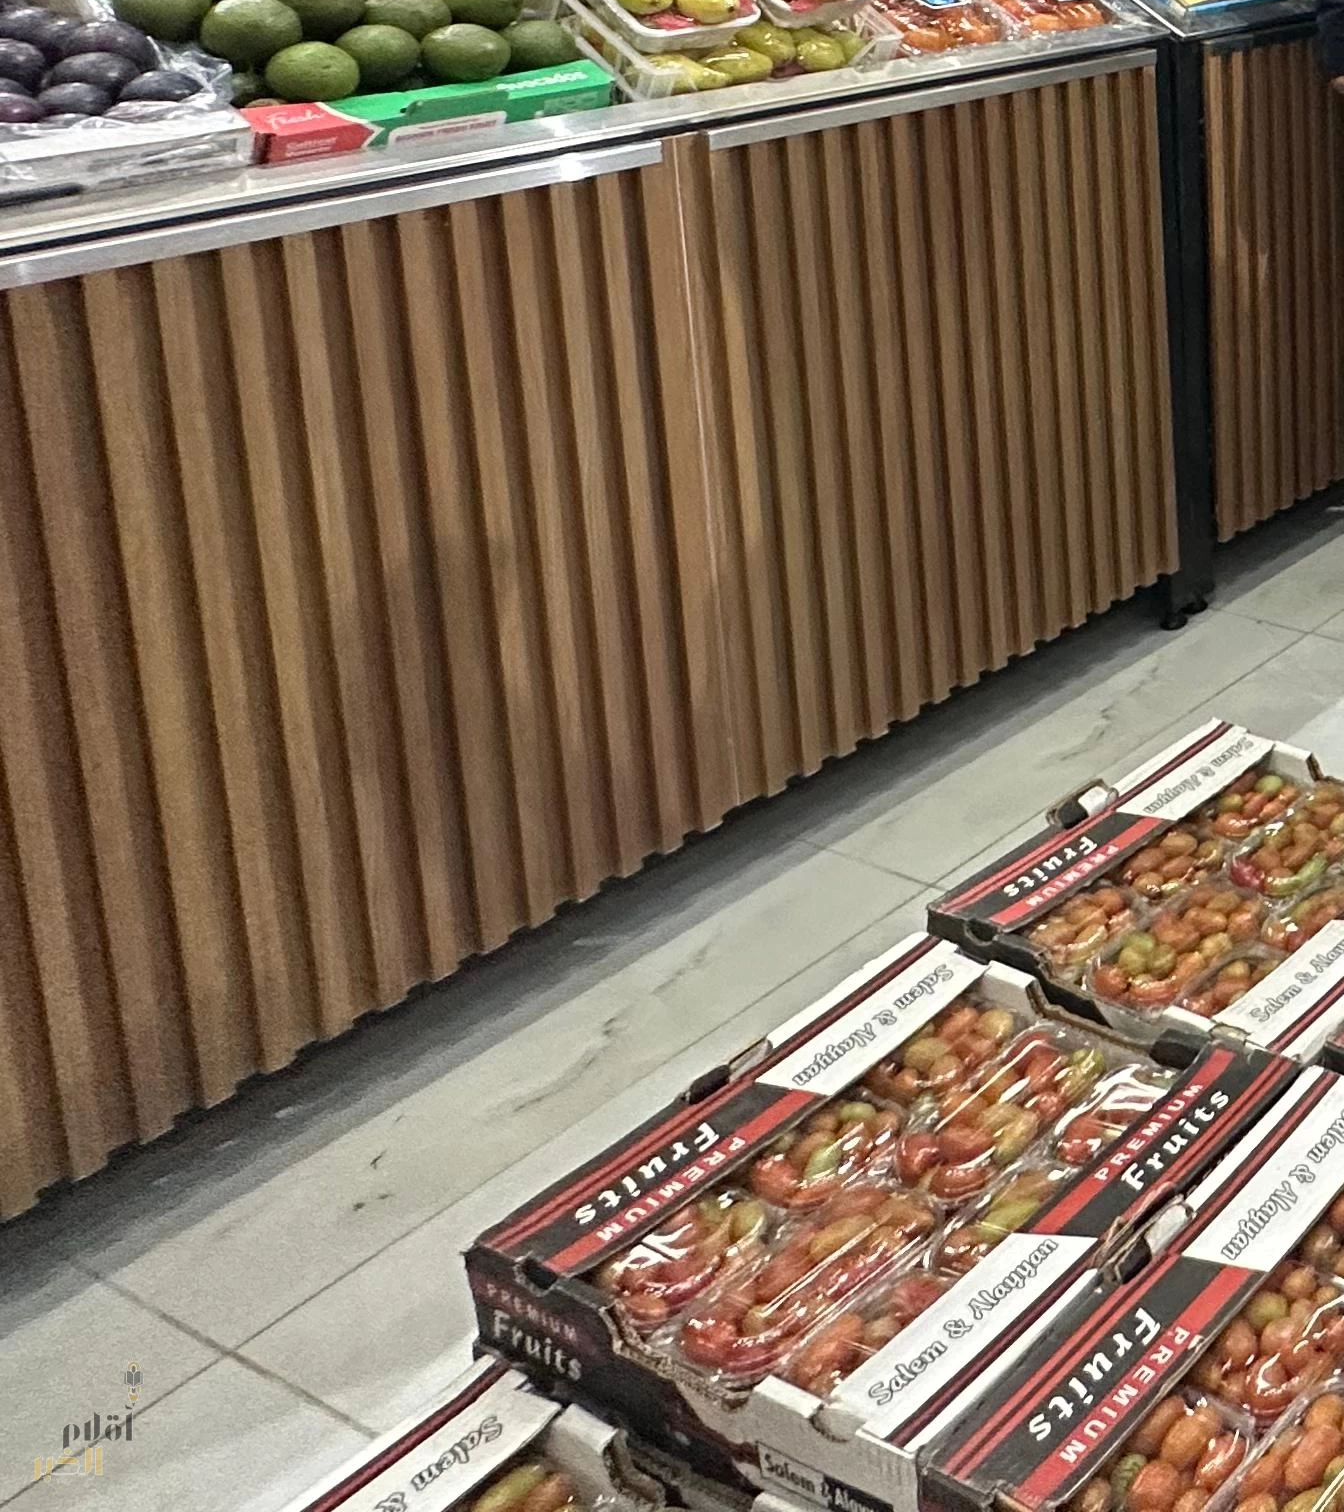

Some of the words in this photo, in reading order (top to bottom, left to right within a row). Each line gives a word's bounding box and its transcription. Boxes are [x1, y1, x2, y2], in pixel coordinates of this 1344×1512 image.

[265, 109, 326, 131] Fresh
[1209, 736, 1255, 767] Salem
[1003, 835, 1098, 898] Fruits
[1026, 844, 1120, 908] PREMIUM
[893, 964, 954, 1011] Salem
[1249, 984, 1300, 1024] Salem
[791, 1022, 876, 1087] Alayyan
[1093, 1082, 1203, 1182] PREMIUM
[1120, 1089, 1231, 1192] Fruits
[574, 1121, 720, 1226] Fruits
[596, 1136, 747, 1243] PREMIUM
[1220, 1180, 1298, 1261] Alayyan
[493, 1308, 582, 1382] Fruits
[868, 1338, 948, 1407] Salem
[968, 1237, 1060, 1322] Alayyan
[1028, 1306, 1162, 1441] Fruits
[1060, 1325, 1192, 1464] PREMIUM
[410, 1414, 504, 1492] Salem
[764, 1453, 816, 1494] Salem
